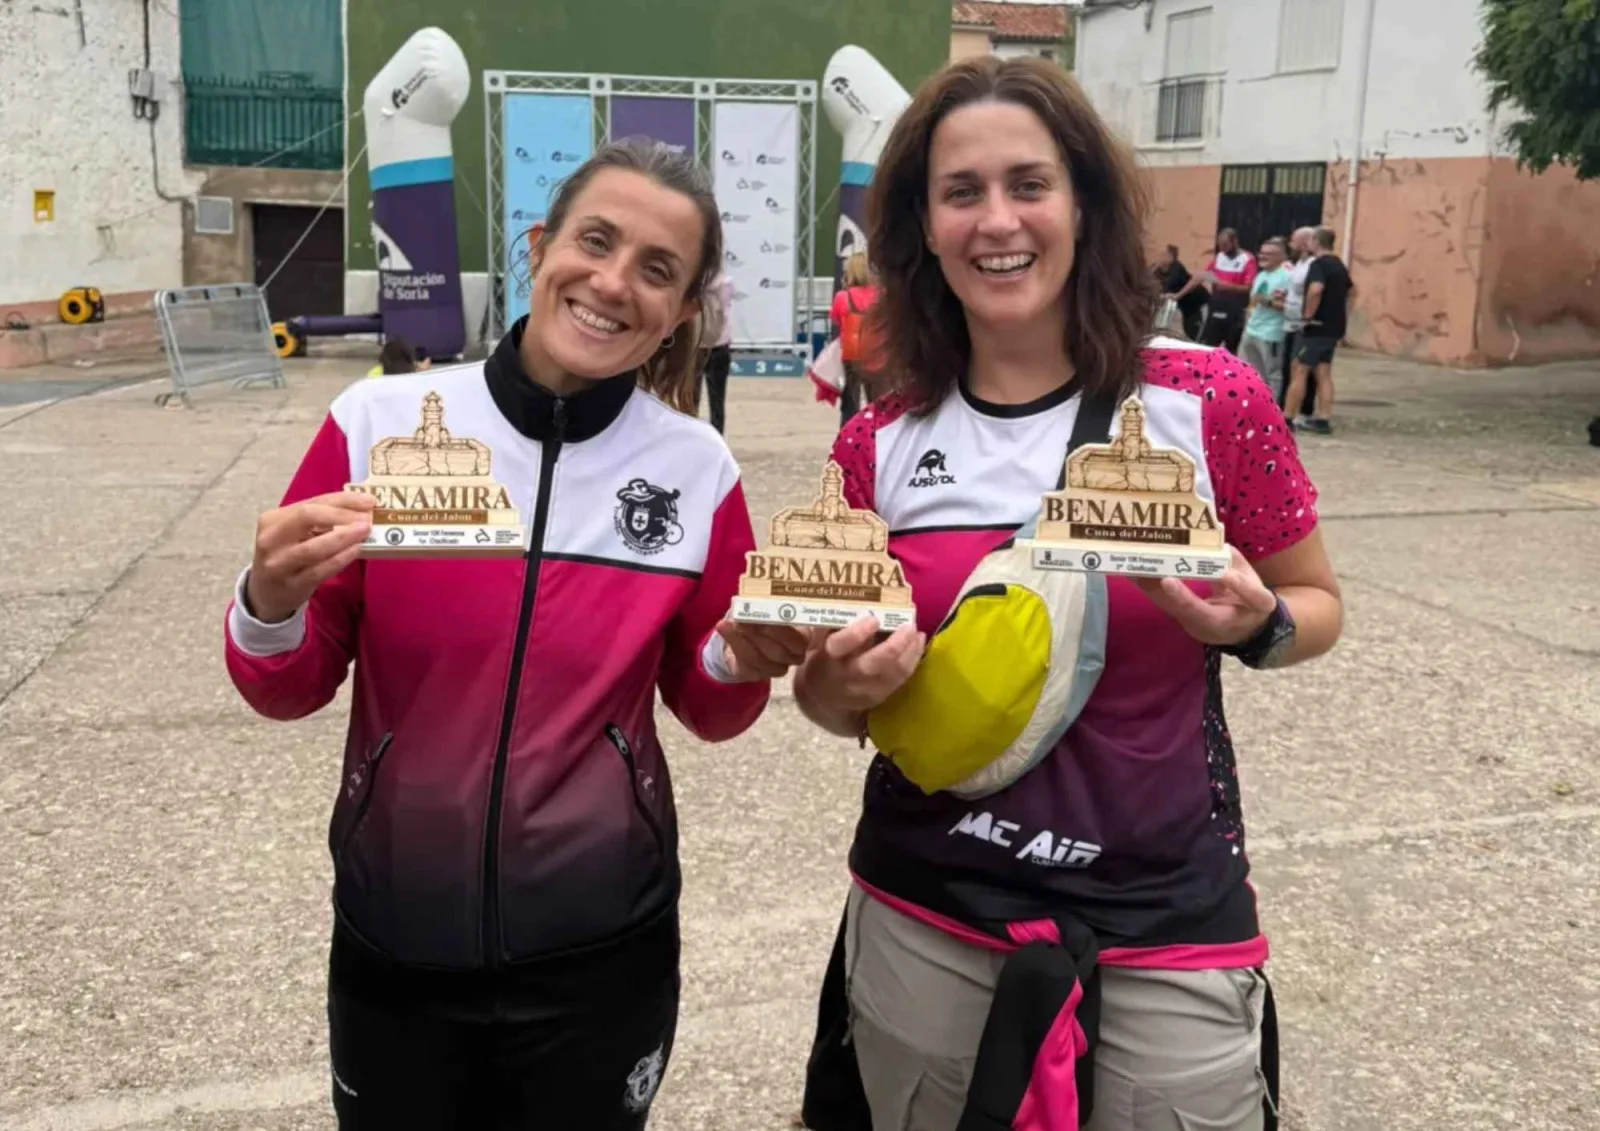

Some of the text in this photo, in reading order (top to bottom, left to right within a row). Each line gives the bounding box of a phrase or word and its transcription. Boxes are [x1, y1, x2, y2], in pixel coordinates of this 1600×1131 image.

[396, 288, 430, 301] Soria
[755, 361, 767, 374] 3
[387, 511, 418, 521] Cuna
[421, 511, 438, 521] del
[1045, 497, 1217, 530] BENAMIRA
[1084, 526, 1116, 537] Cuna
[1119, 528, 1137, 538] del
[749, 555, 905, 588] BENAMIRA
[785, 584, 815, 593] Cuna
[816, 586, 833, 595] del
